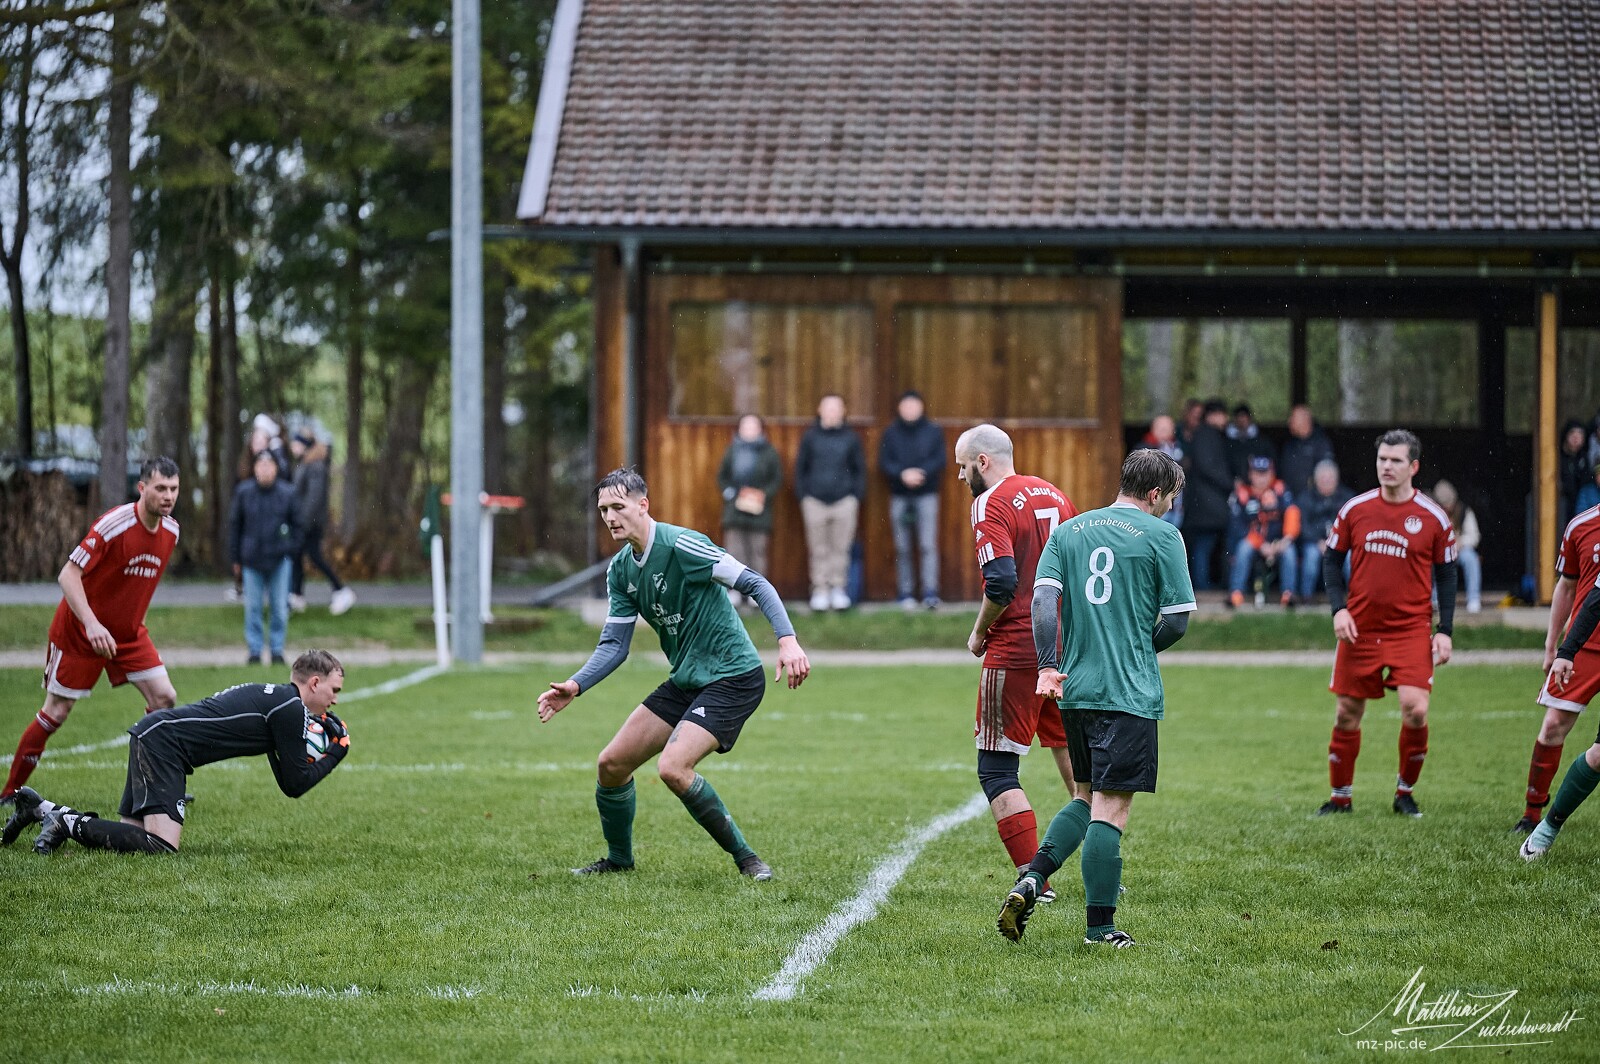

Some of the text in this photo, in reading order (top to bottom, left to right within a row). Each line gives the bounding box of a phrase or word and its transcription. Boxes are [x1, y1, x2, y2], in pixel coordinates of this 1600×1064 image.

[1012, 491, 1028, 510] SV
[1034, 507, 1060, 539] 7
[1072, 517, 1144, 537] SV Leobendorf
[1085, 546, 1115, 605] 8
